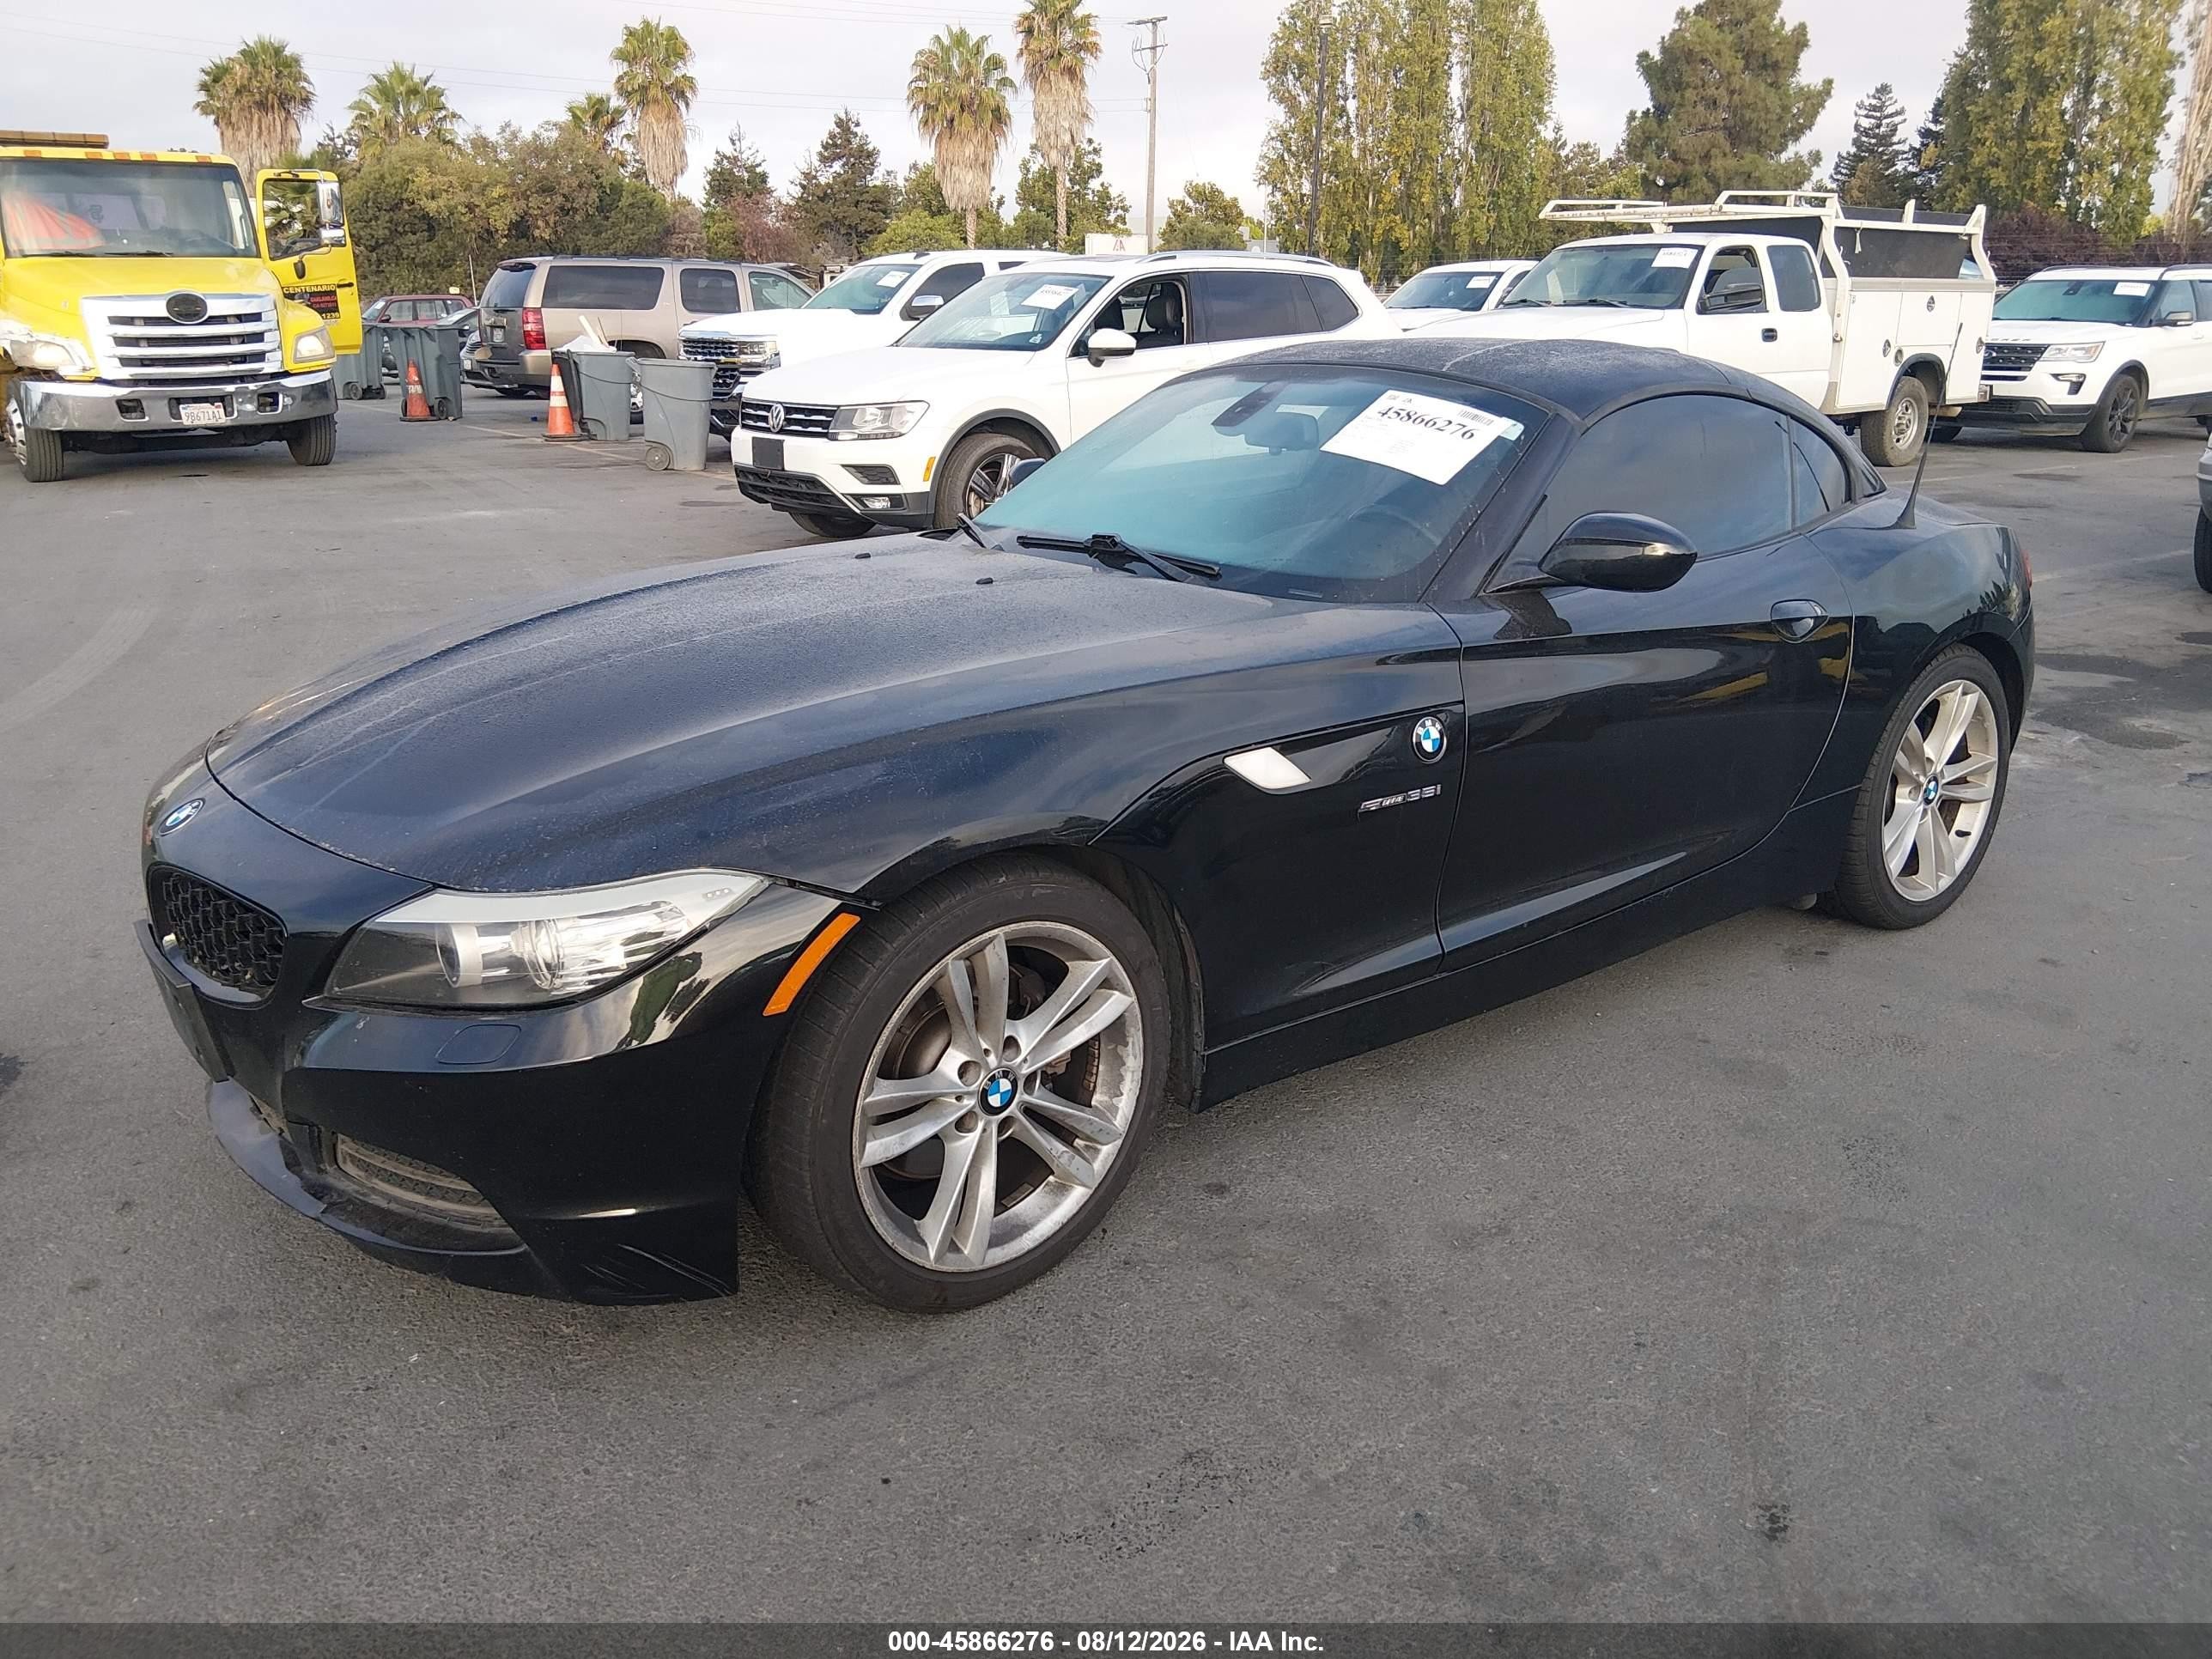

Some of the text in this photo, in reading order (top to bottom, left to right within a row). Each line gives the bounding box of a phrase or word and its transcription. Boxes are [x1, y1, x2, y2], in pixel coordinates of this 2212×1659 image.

[283, 284, 336, 294] CENTENARIO
[185, 410, 222, 422] 98671A1
[1377, 406, 1475, 440] 45866276
[983, 1070, 1016, 1091] BMW
